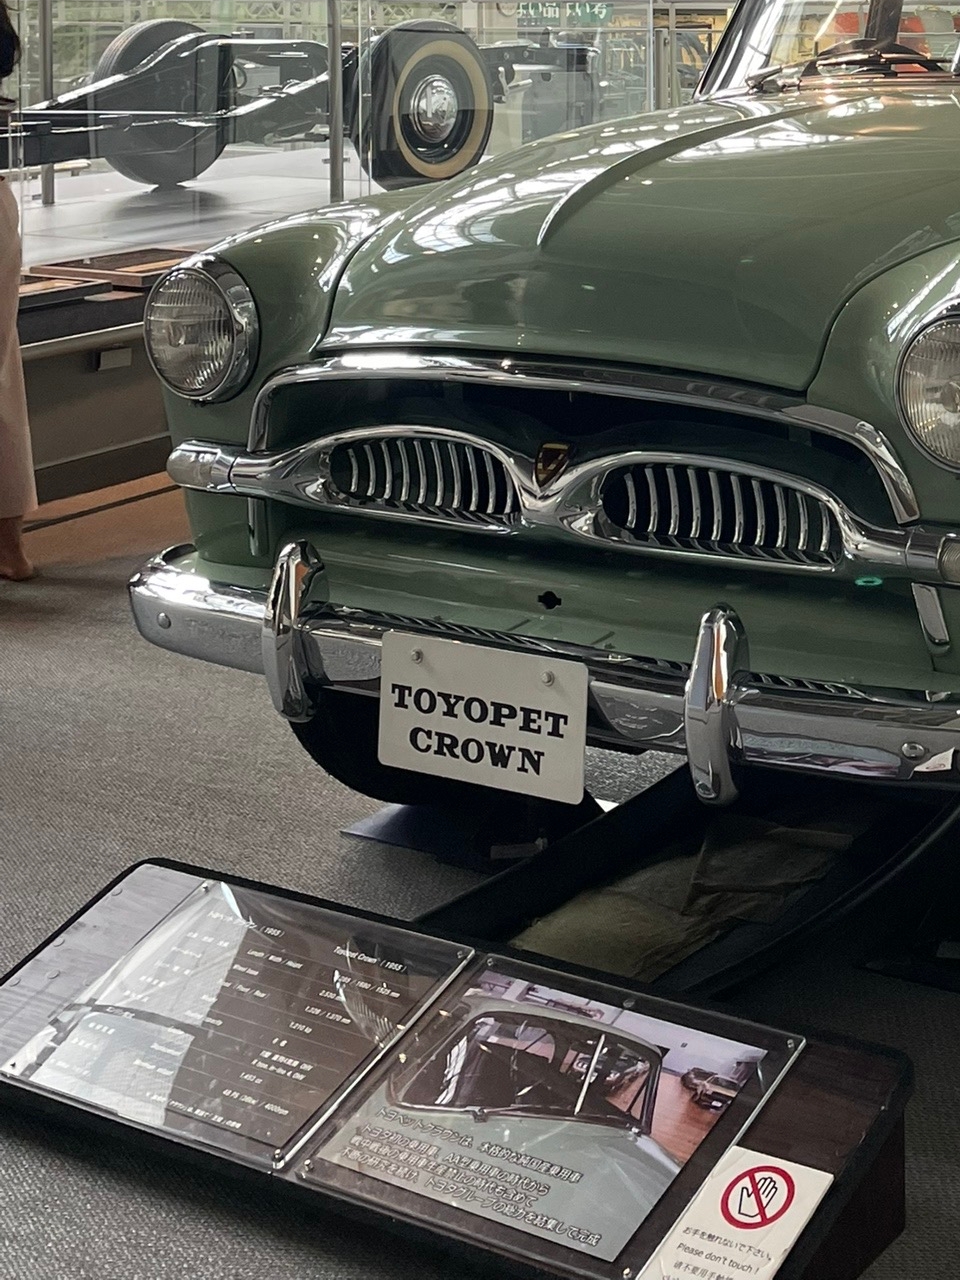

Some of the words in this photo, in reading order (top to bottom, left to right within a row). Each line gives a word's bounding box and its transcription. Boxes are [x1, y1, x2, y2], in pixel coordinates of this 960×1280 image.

[391, 683, 568, 739] TOYOPET
[409, 726, 545, 776] CROWN
[357, 953, 379, 963] Crown
[677, 1242, 704, 1257] Please
[705, 1251, 728, 1266] don't
[728, 1259, 753, 1273] touch
[683, 1226, 772, 1261] お手を触れないで下さい。
